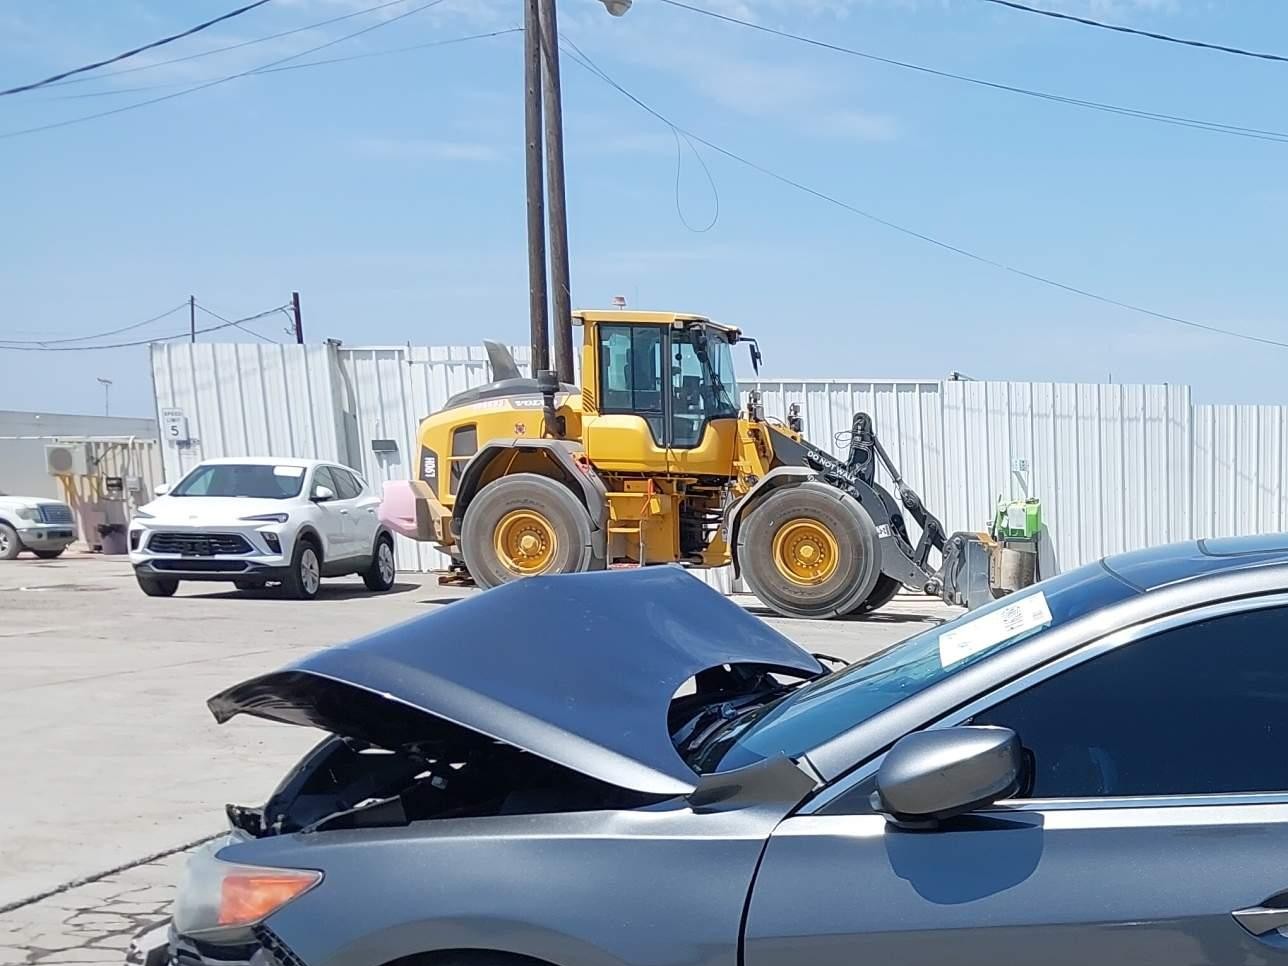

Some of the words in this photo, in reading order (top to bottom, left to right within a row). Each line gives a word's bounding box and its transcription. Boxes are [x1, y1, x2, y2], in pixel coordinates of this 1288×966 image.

[170, 425, 179, 437] 5
[807, 450, 820, 461] DO
[819, 457, 836, 471] NOT
[836, 466, 859, 484] WALK
